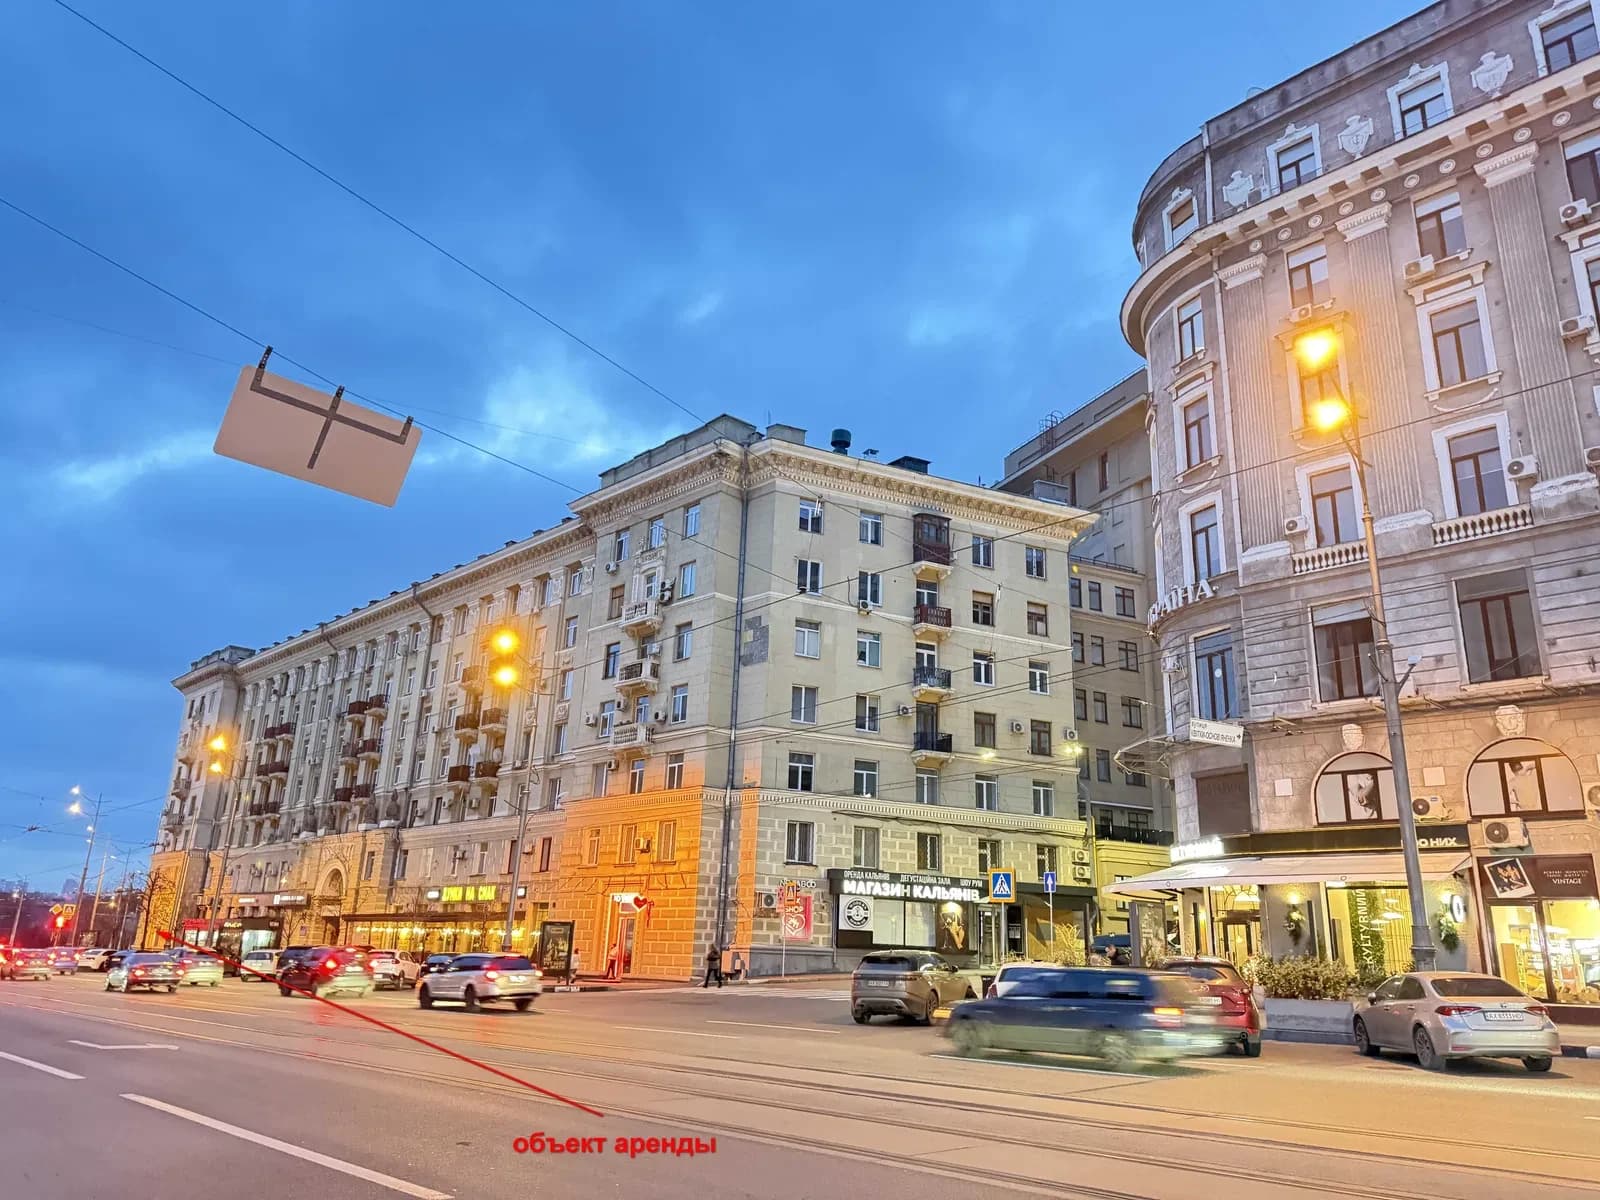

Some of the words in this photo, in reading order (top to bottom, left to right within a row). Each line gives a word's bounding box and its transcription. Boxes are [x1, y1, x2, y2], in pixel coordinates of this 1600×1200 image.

[1430, 837, 1457, 847] НИХ
[938, 877, 951, 885] ЗАЛА
[843, 880, 911, 897] МАГАЗИН
[913, 884, 980, 901] КАЛЬЯНІВ
[785, 905, 804, 914] SHOP
